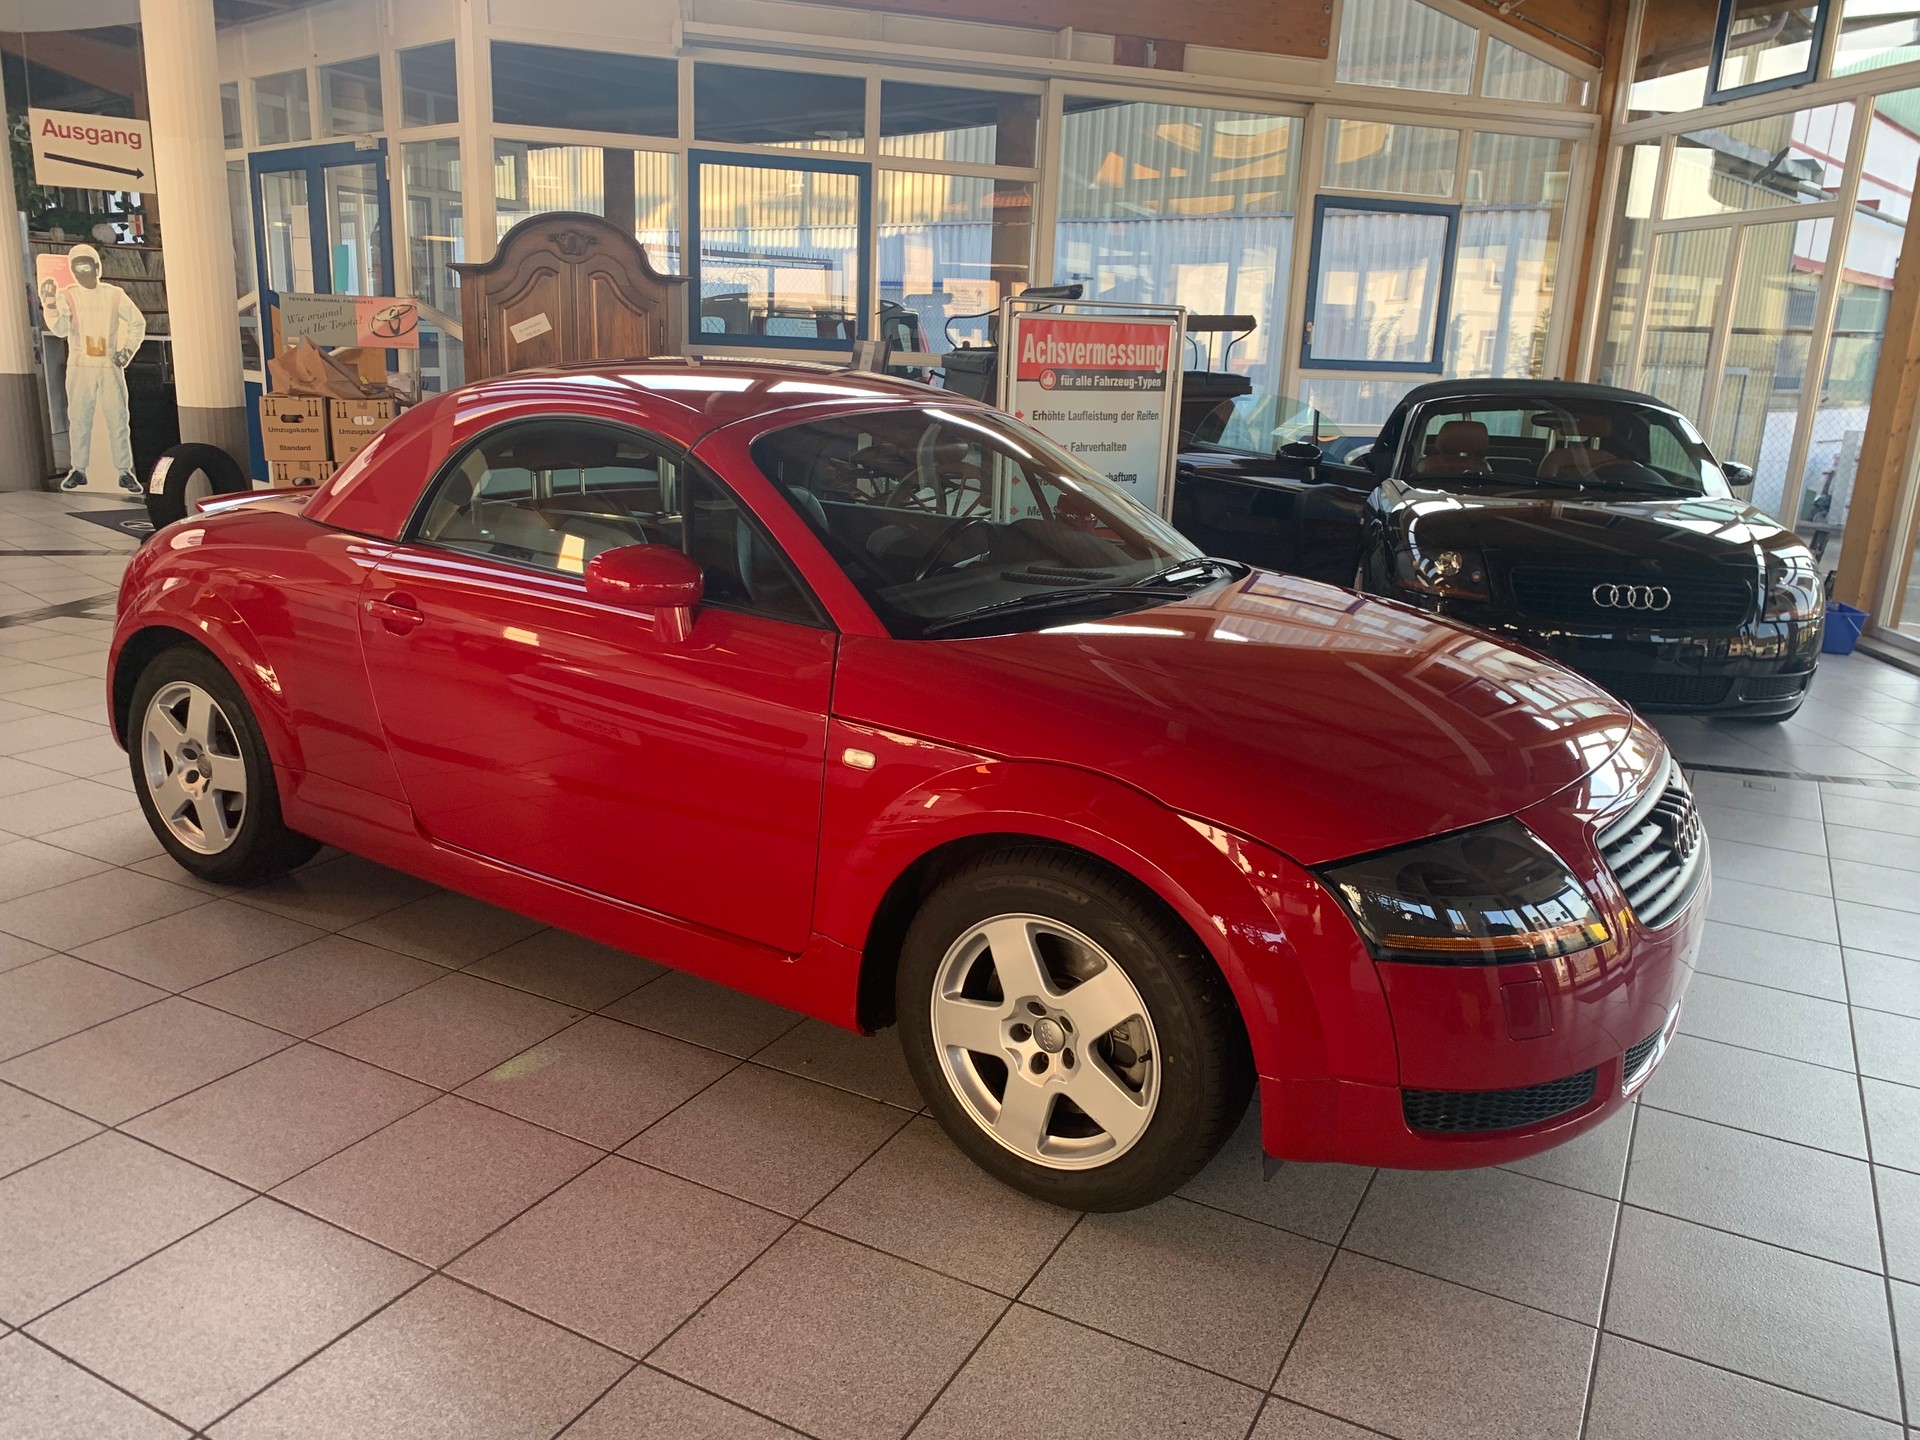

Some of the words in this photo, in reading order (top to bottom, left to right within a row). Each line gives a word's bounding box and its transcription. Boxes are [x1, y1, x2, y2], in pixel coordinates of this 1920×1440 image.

[42, 118, 143, 150] Ausgang
[287, 314, 305, 324] Wie
[307, 306, 343, 321] original
[299, 327, 310, 335] ist
[314, 322, 327, 334] Ihr
[330, 316, 363, 330] Toyota?
[1022, 333, 1165, 374] Achsvermessung
[1060, 374, 1073, 386] für
[1076, 375, 1092, 387] alle
[1094, 375, 1162, 389] Fahrzeug-Typen
[1032, 410, 1066, 421] Erhöhte
[1068, 410, 1118, 423] Laufleistung
[1121, 410, 1134, 421] der
[1136, 410, 1159, 421] Reifen
[1071, 442, 1127, 452] Fahrverhalten
